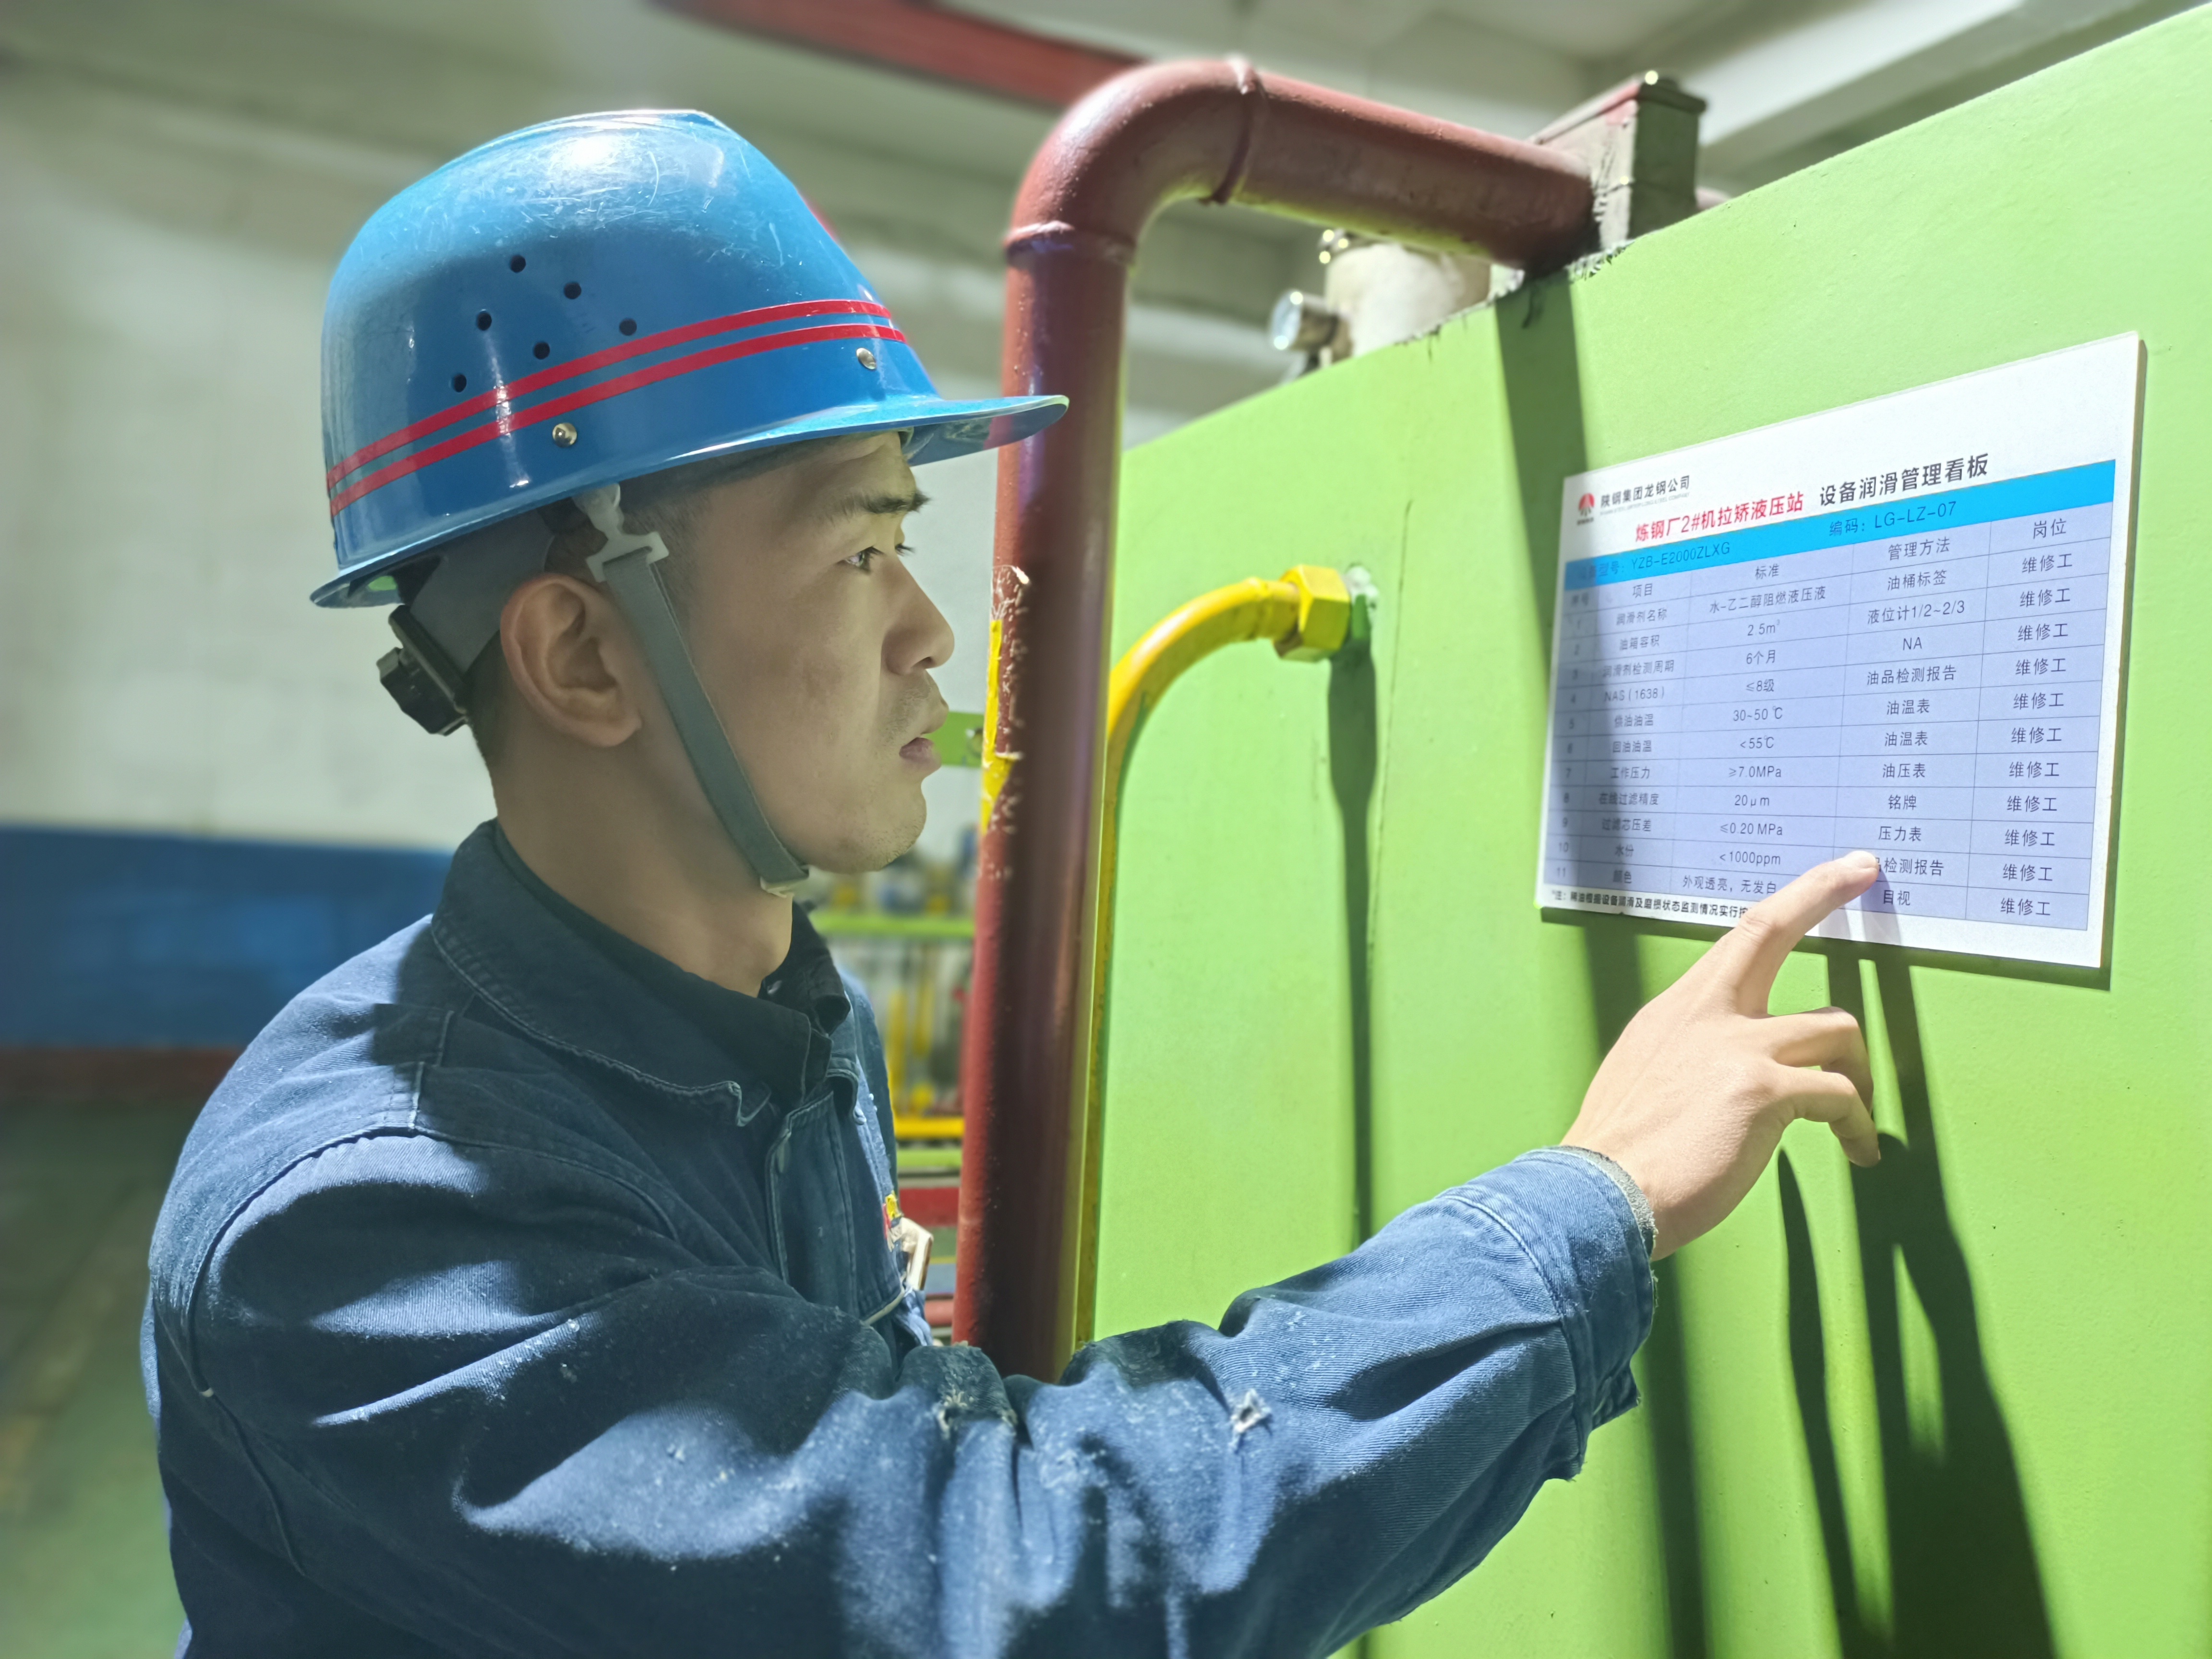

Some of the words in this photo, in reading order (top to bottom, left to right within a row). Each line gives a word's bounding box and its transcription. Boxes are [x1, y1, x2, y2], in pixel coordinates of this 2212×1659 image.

[1635, 491, 1803, 542] 炼钢厂2#机拉矫液压站
[1820, 453, 1988, 506] 设备润滑管理看板
[1633, 583, 1653, 599] 项目
[1755, 564, 1779, 580] 标准
[1888, 536, 1950, 561] 管理方法
[2032, 518, 2067, 540] 岗位
[1616, 608, 1667, 625] 润滑剂名称
[1887, 569, 1947, 591] 油桶标签
[2021, 553, 2073, 574] 维修工
[1619, 635, 1660, 650] 油箱容积
[2020, 588, 2070, 608] 维修工
[1603, 660, 1675, 678] 润滑剂检测周期
[1746, 649, 1776, 665] 6个月
[1903, 637, 1923, 650] NA
[2017, 623, 2068, 642] 维修工
[1745, 679, 1774, 692] ≤8级
[1867, 664, 1957, 686] 油品检测报告
[2015, 658, 2067, 676] 维修工
[1614, 713, 1654, 728] 供油油温
[1887, 698, 1930, 715] 油温表
[2013, 692, 2064, 710] 维修工
[1612, 740, 1652, 753] 回油油温
[1884, 730, 1928, 747] 油温表
[2011, 726, 2062, 744] 维修工
[1611, 766, 1650, 779] 工作压力
[1728, 765, 1782, 778] ≥7.0MPa
[1882, 762, 1926, 779] 油压表
[2008, 760, 2060, 779] 维修工
[1599, 793, 1659, 805] 在线过滤精度
[1887, 794, 1917, 810] 铭牌
[2007, 795, 2058, 812] 维修工
[1562, 817, 1568, 828] 9
[1602, 818, 1652, 832] 过滤芯压差
[1878, 826, 1922, 842] 压力表
[2004, 829, 2055, 847] 维修工
[1559, 842, 1569, 853] 10
[1614, 843, 1634, 857] 水份
[2002, 863, 2053, 881] 维修工
[1557, 867, 1566, 878] 11
[1883, 889, 1911, 906] 目视
[2000, 897, 2051, 916] 维修工
